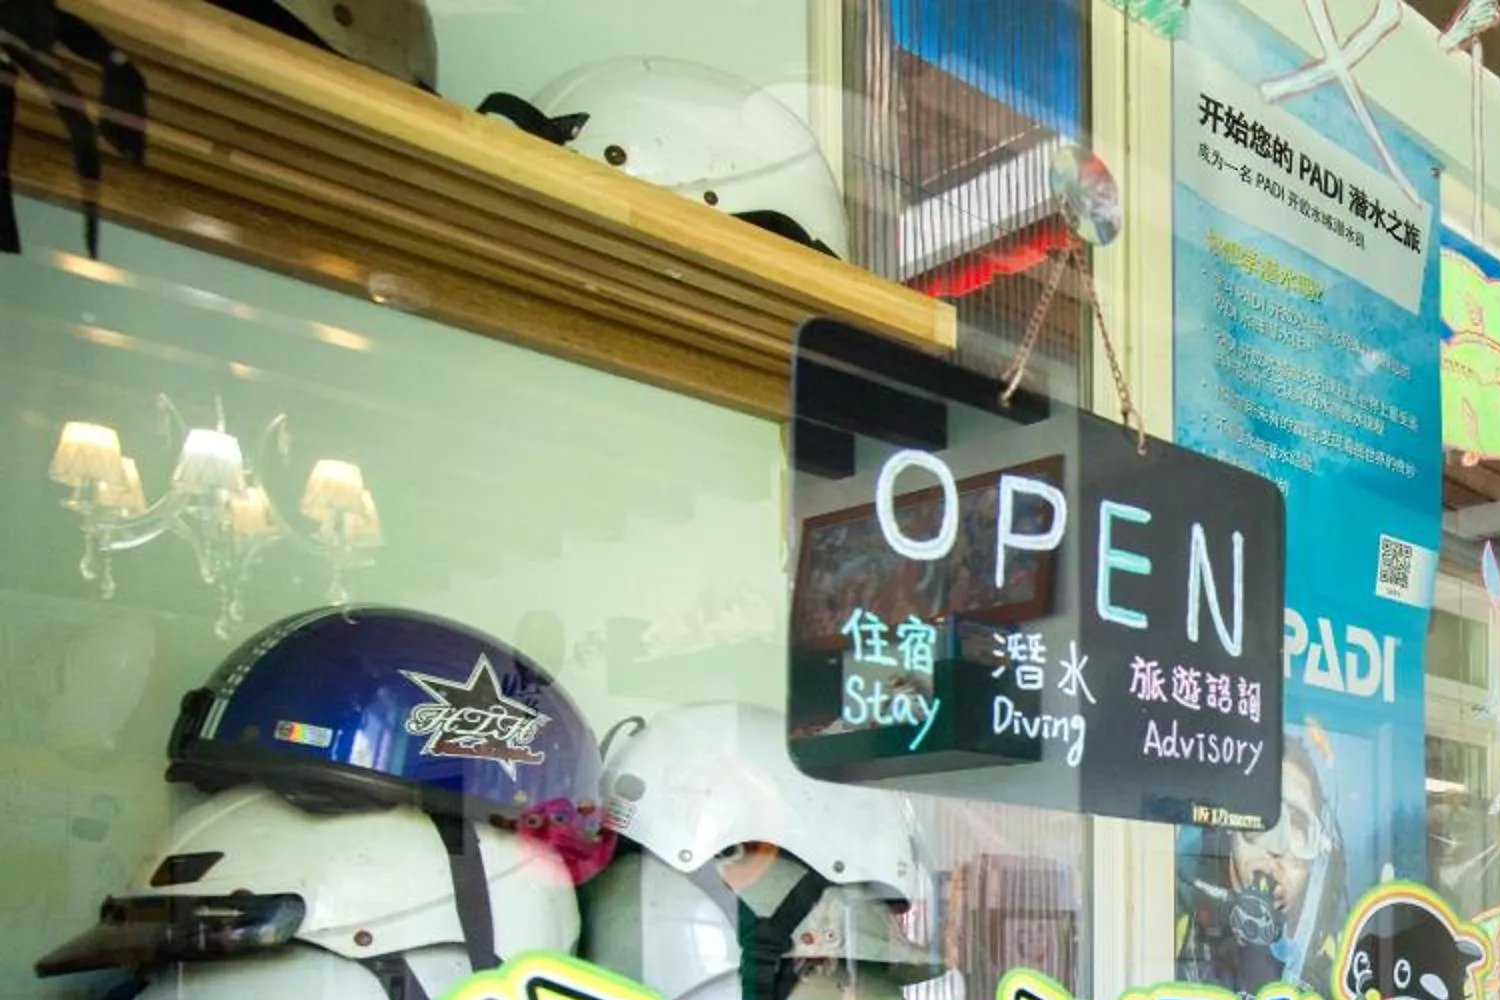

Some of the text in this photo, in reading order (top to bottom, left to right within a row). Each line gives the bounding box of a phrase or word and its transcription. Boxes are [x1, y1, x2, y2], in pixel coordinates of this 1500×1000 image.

[1199, 93, 1293, 174] 开始您的
[1300, 153, 1344, 204] PADI
[1256, 173, 1285, 201] PADI
[875, 448, 1245, 656] OPEN
[842, 607, 938, 676] 住宿
[992, 632, 1096, 706] 潛水
[1284, 607, 1397, 704] PADI
[842, 675, 1264, 776] Stay Diving Advisory
